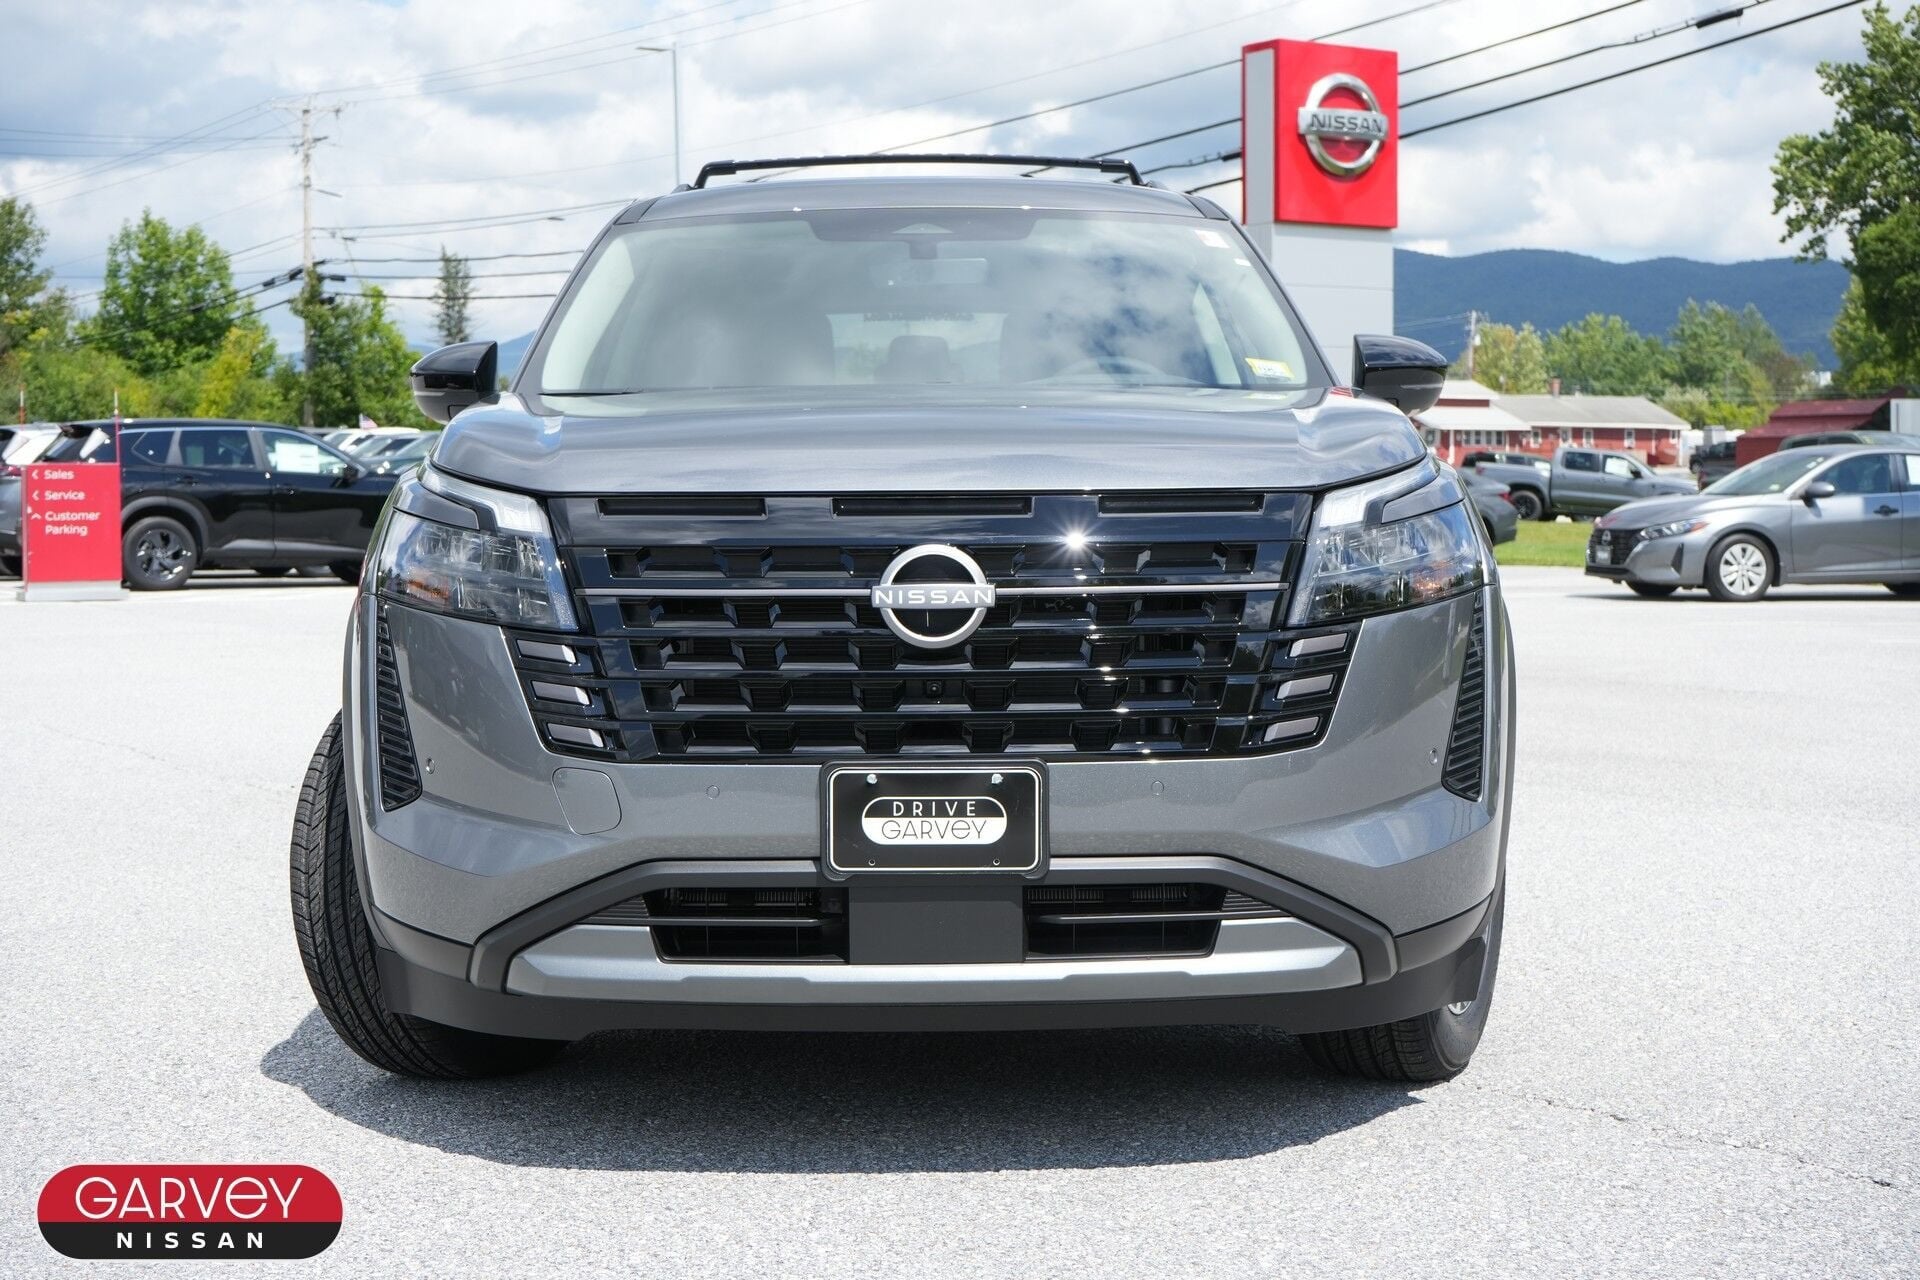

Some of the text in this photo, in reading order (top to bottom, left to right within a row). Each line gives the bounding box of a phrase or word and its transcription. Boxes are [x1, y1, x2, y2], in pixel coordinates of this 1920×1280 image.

[1310, 113, 1382, 133] NISSAN
[44, 469, 74, 480] Sales
[44, 490, 85, 501] Service
[45, 511, 100, 521] Customer
[45, 524, 88, 536] Parking
[875, 589, 992, 605] NISSAN
[892, 801, 976, 817] DRIVE
